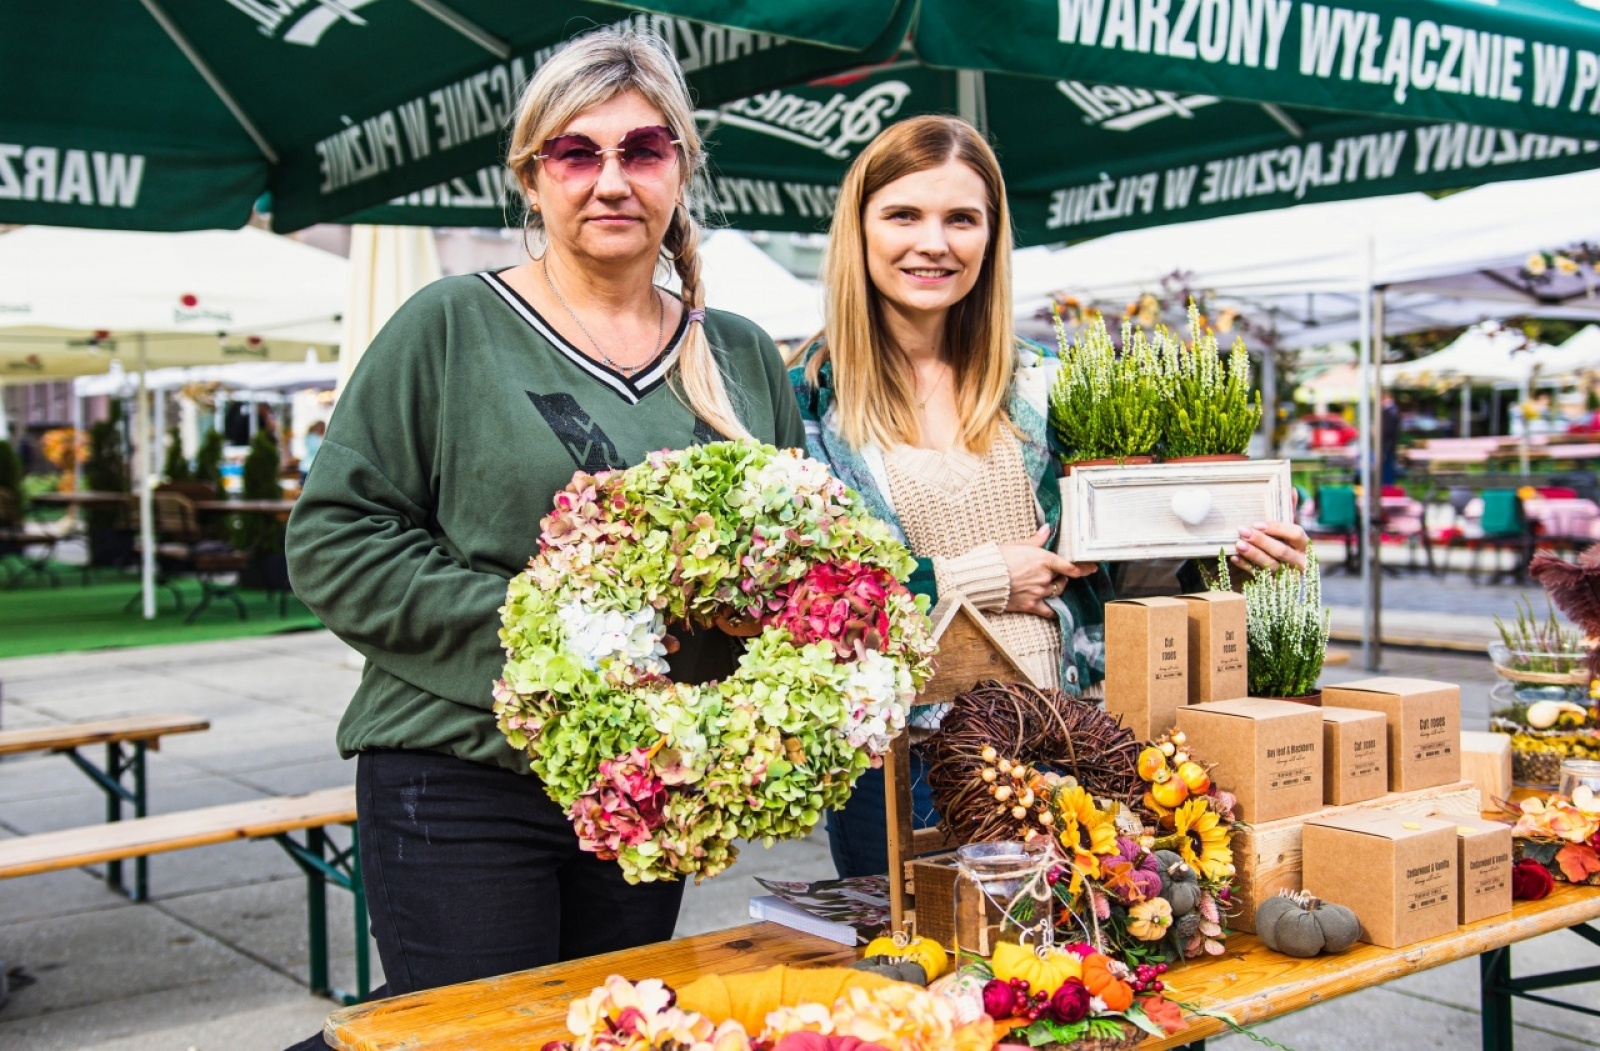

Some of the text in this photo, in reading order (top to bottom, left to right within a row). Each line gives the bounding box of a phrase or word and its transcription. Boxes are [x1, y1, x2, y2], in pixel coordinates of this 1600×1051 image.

[1057, 0, 1292, 71] WARZONY
[1299, 2, 1525, 105] WYŁĄCZNIE
[1532, 41, 1569, 109] W
[1419, 716, 1446, 731] Cut roses
[1406, 864, 1431, 879] Cedarwood
[1434, 859, 1450, 871] Vanilla
